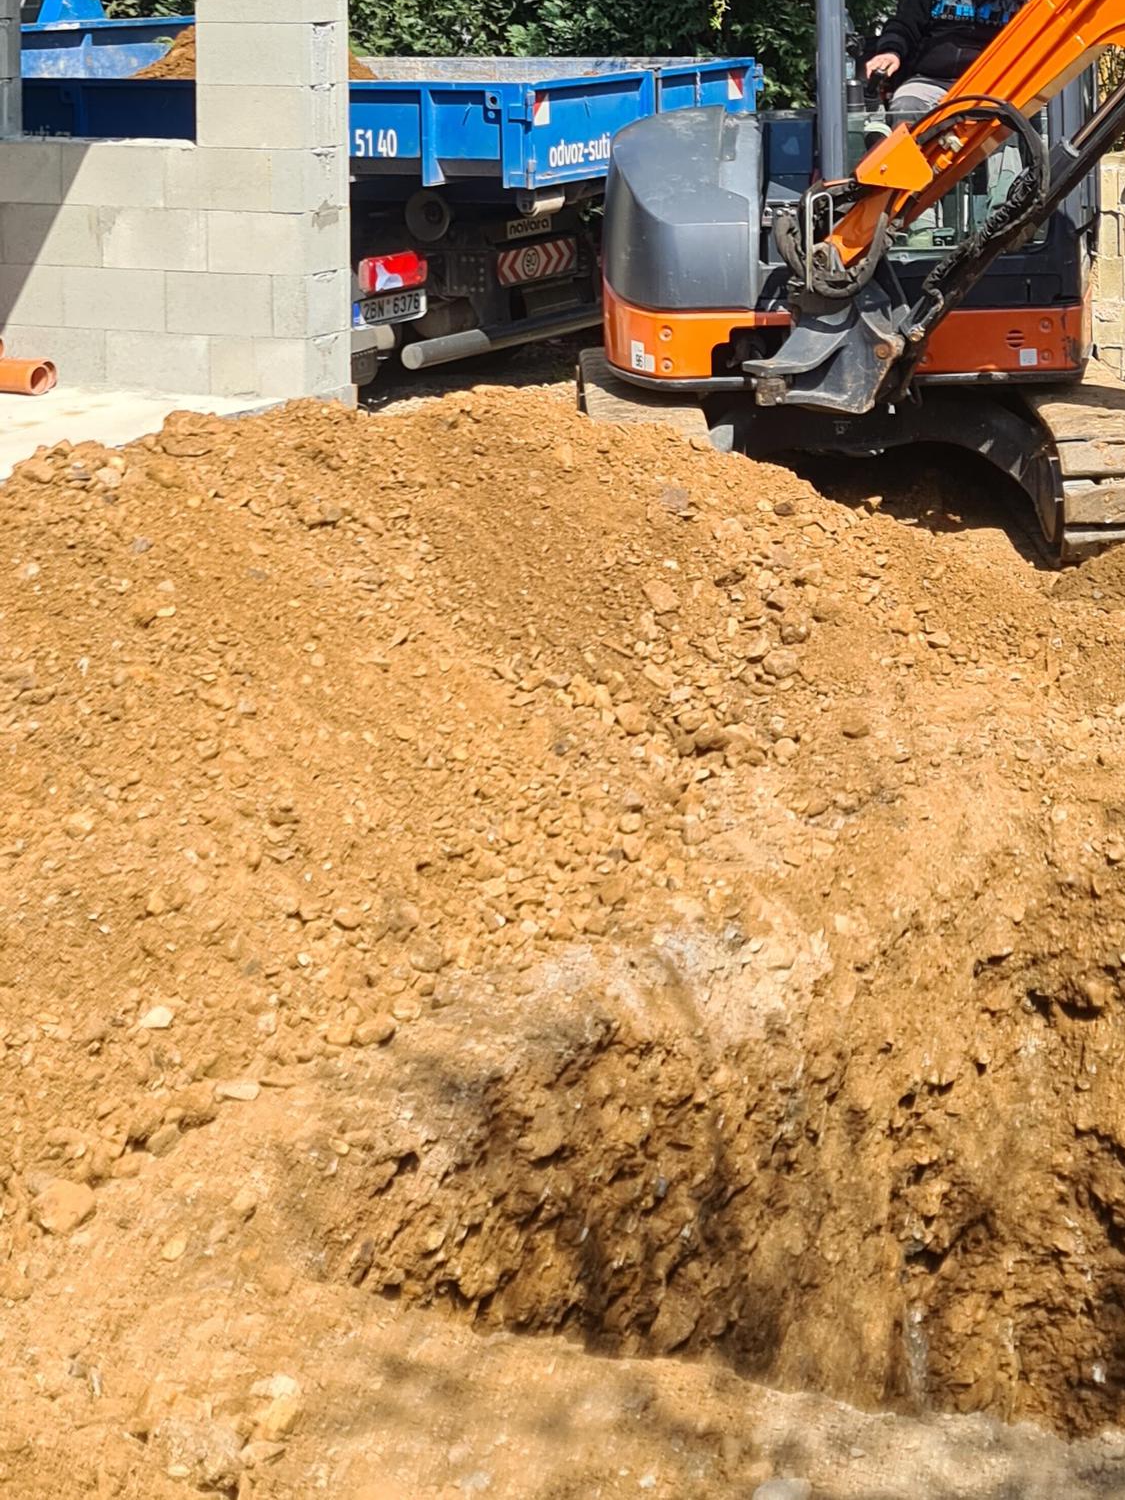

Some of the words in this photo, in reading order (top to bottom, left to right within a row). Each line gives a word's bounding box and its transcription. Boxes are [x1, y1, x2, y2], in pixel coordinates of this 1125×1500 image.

[355, 129, 374, 157] 51
[377, 129, 398, 157] 40
[364, 300, 385, 320] 2BN
